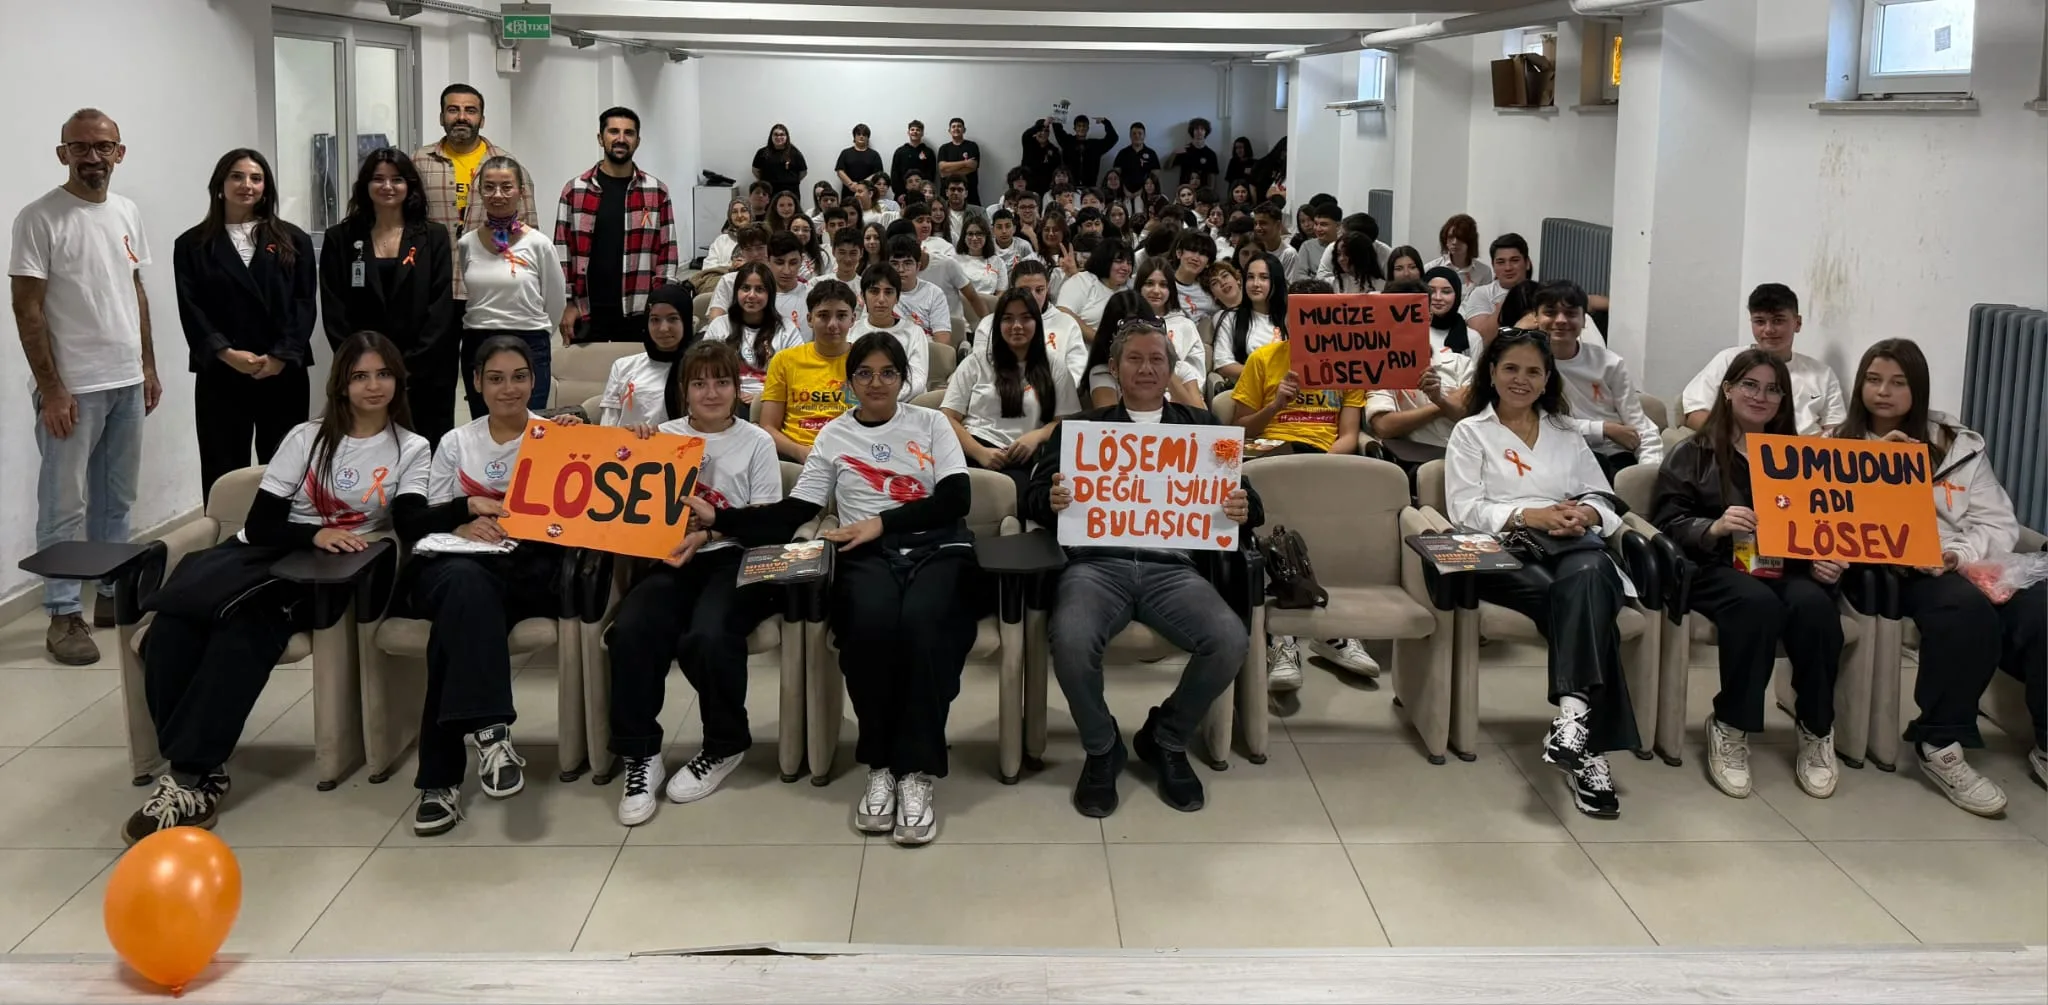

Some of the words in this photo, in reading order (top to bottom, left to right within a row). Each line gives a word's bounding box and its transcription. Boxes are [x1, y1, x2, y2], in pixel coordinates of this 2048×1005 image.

[1300, 303, 1375, 325] MUCİZE
[1389, 304, 1423, 323] VE
[1304, 331, 1390, 353] UMUDUN
[1387, 350, 1416, 369] ADI
[1303, 359, 1384, 386] LÖSEV
[792, 388, 842, 403] LÖSEV
[1296, 392, 1326, 406] SEV
[1075, 430, 1198, 473] LÖSEMİ
[1760, 444, 1926, 485] UMUDUN
[509, 453, 698, 526] LÖSEV
[1073, 472, 1151, 504] DEĞİL
[1166, 475, 1237, 506] İYİLİK
[1810, 488, 1854, 514] ADI
[1087, 507, 1211, 540] BULAŞICI
[1787, 519, 1910, 559] LÖSEV
